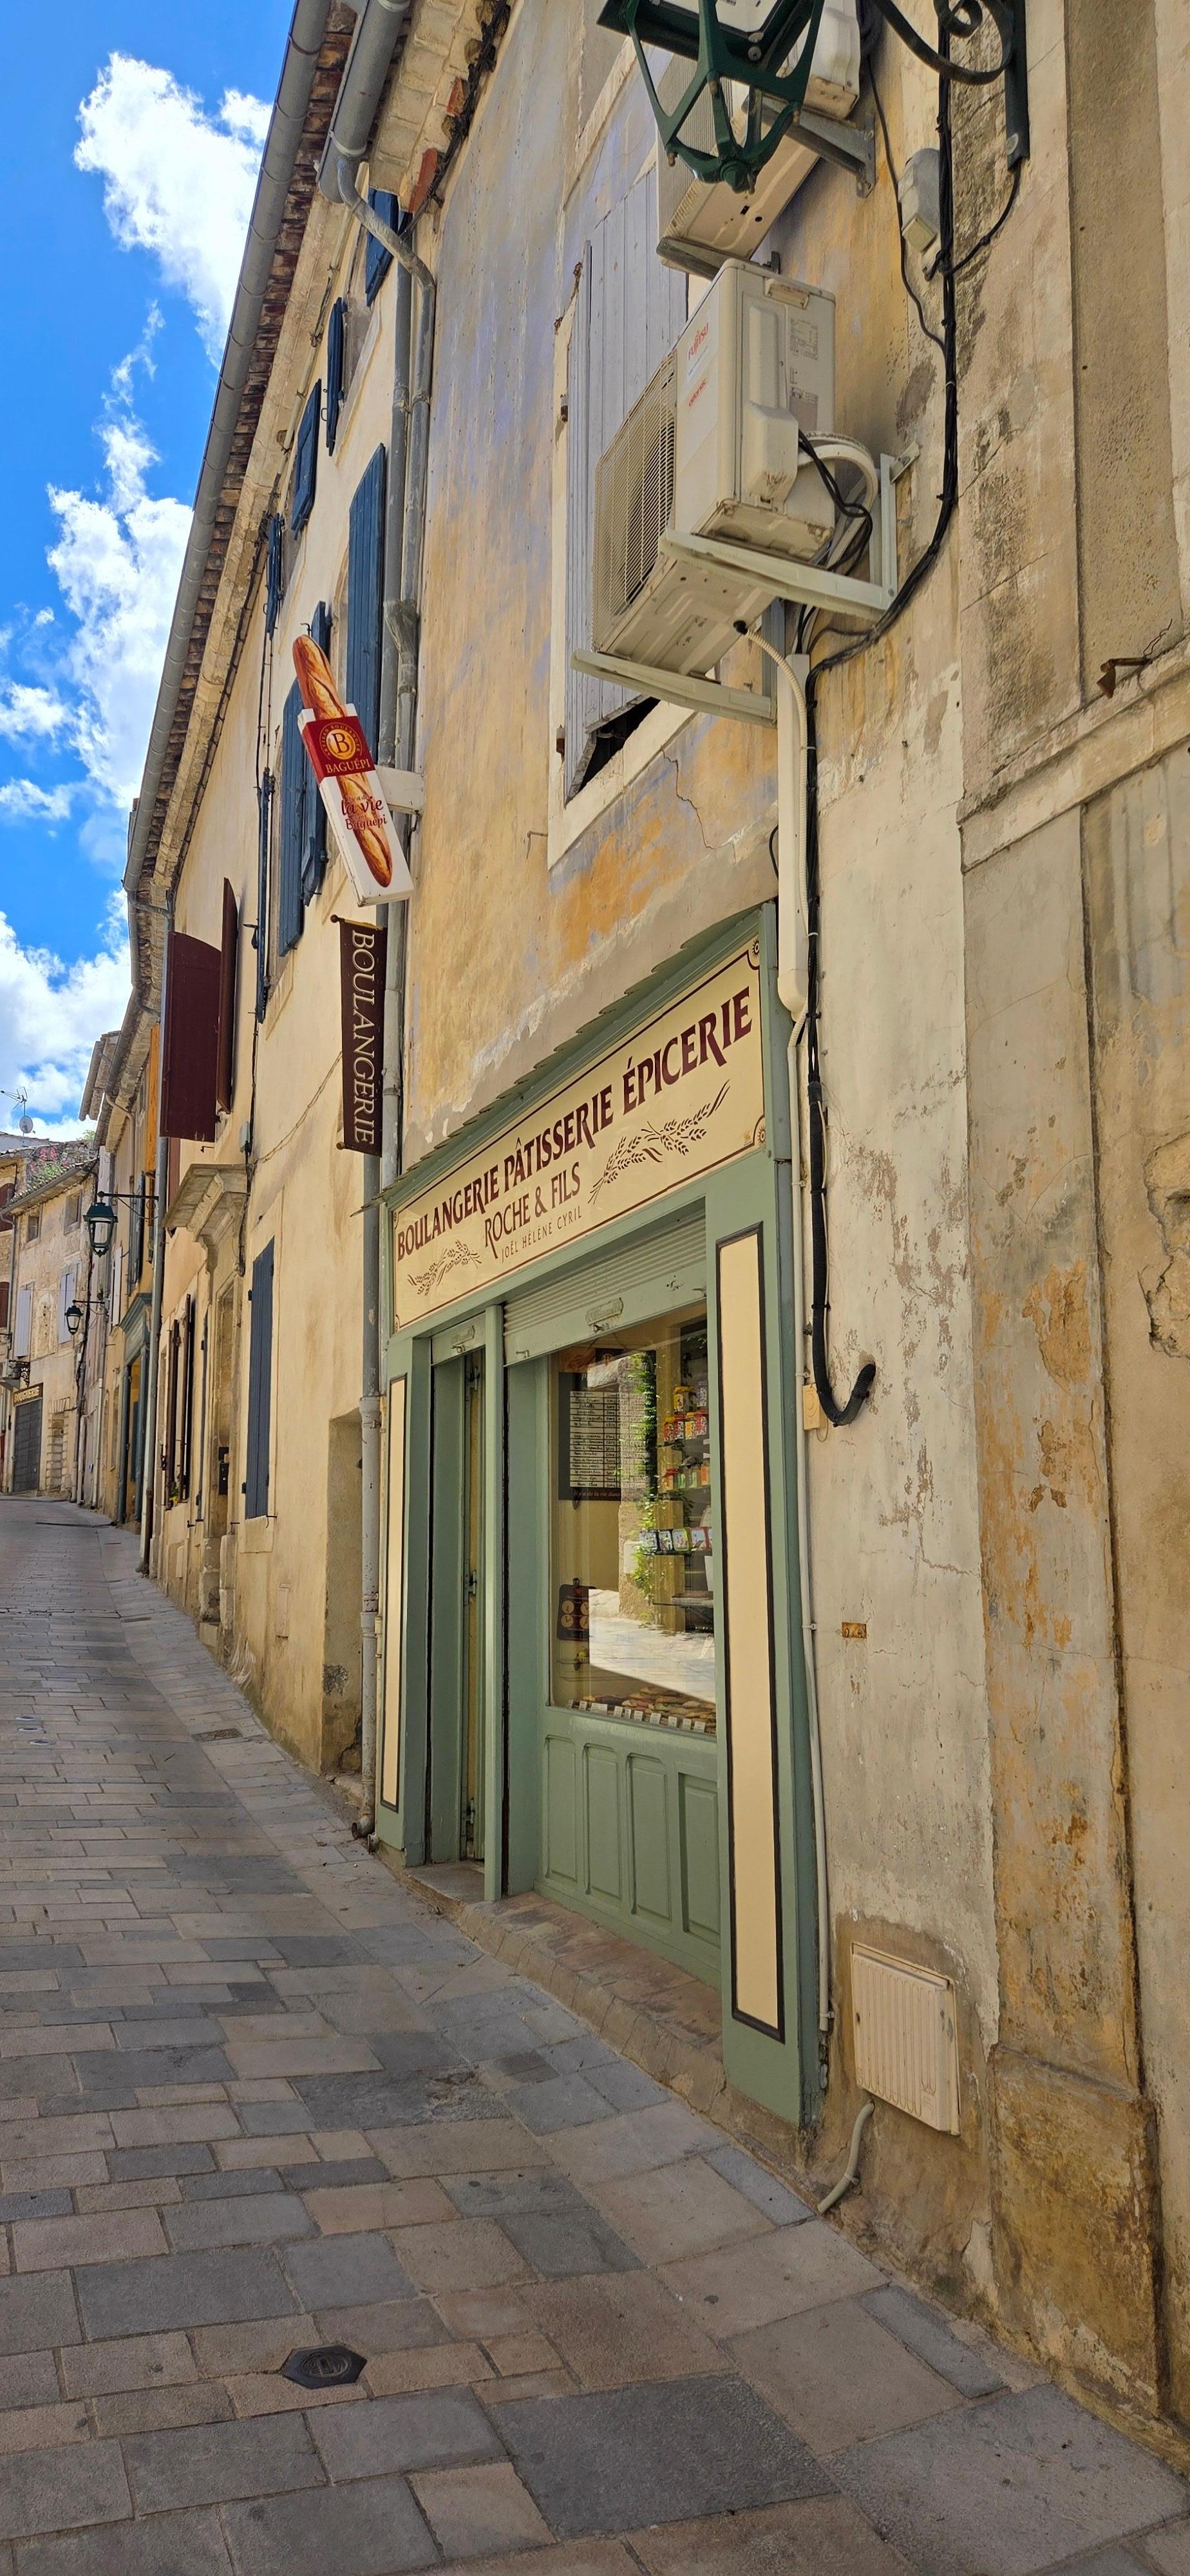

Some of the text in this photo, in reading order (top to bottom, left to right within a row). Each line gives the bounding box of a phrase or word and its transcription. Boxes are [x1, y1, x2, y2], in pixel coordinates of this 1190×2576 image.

[688, 323, 708, 361] FUJITSU
[325, 757, 371, 773] BAGUÉPI
[331, 732, 350, 753] B
[341, 796, 384, 816] la vie
[352, 929, 375, 1145] BOULANGERIE
[397, 986, 753, 1262] BOULANGERIE PÂTISSERIE ÉPICERIE
[484, 1161, 581, 1260] ROCHE & FILS
[502, 1206, 582, 1264] JOËL HÉLÈNE CYRIL
